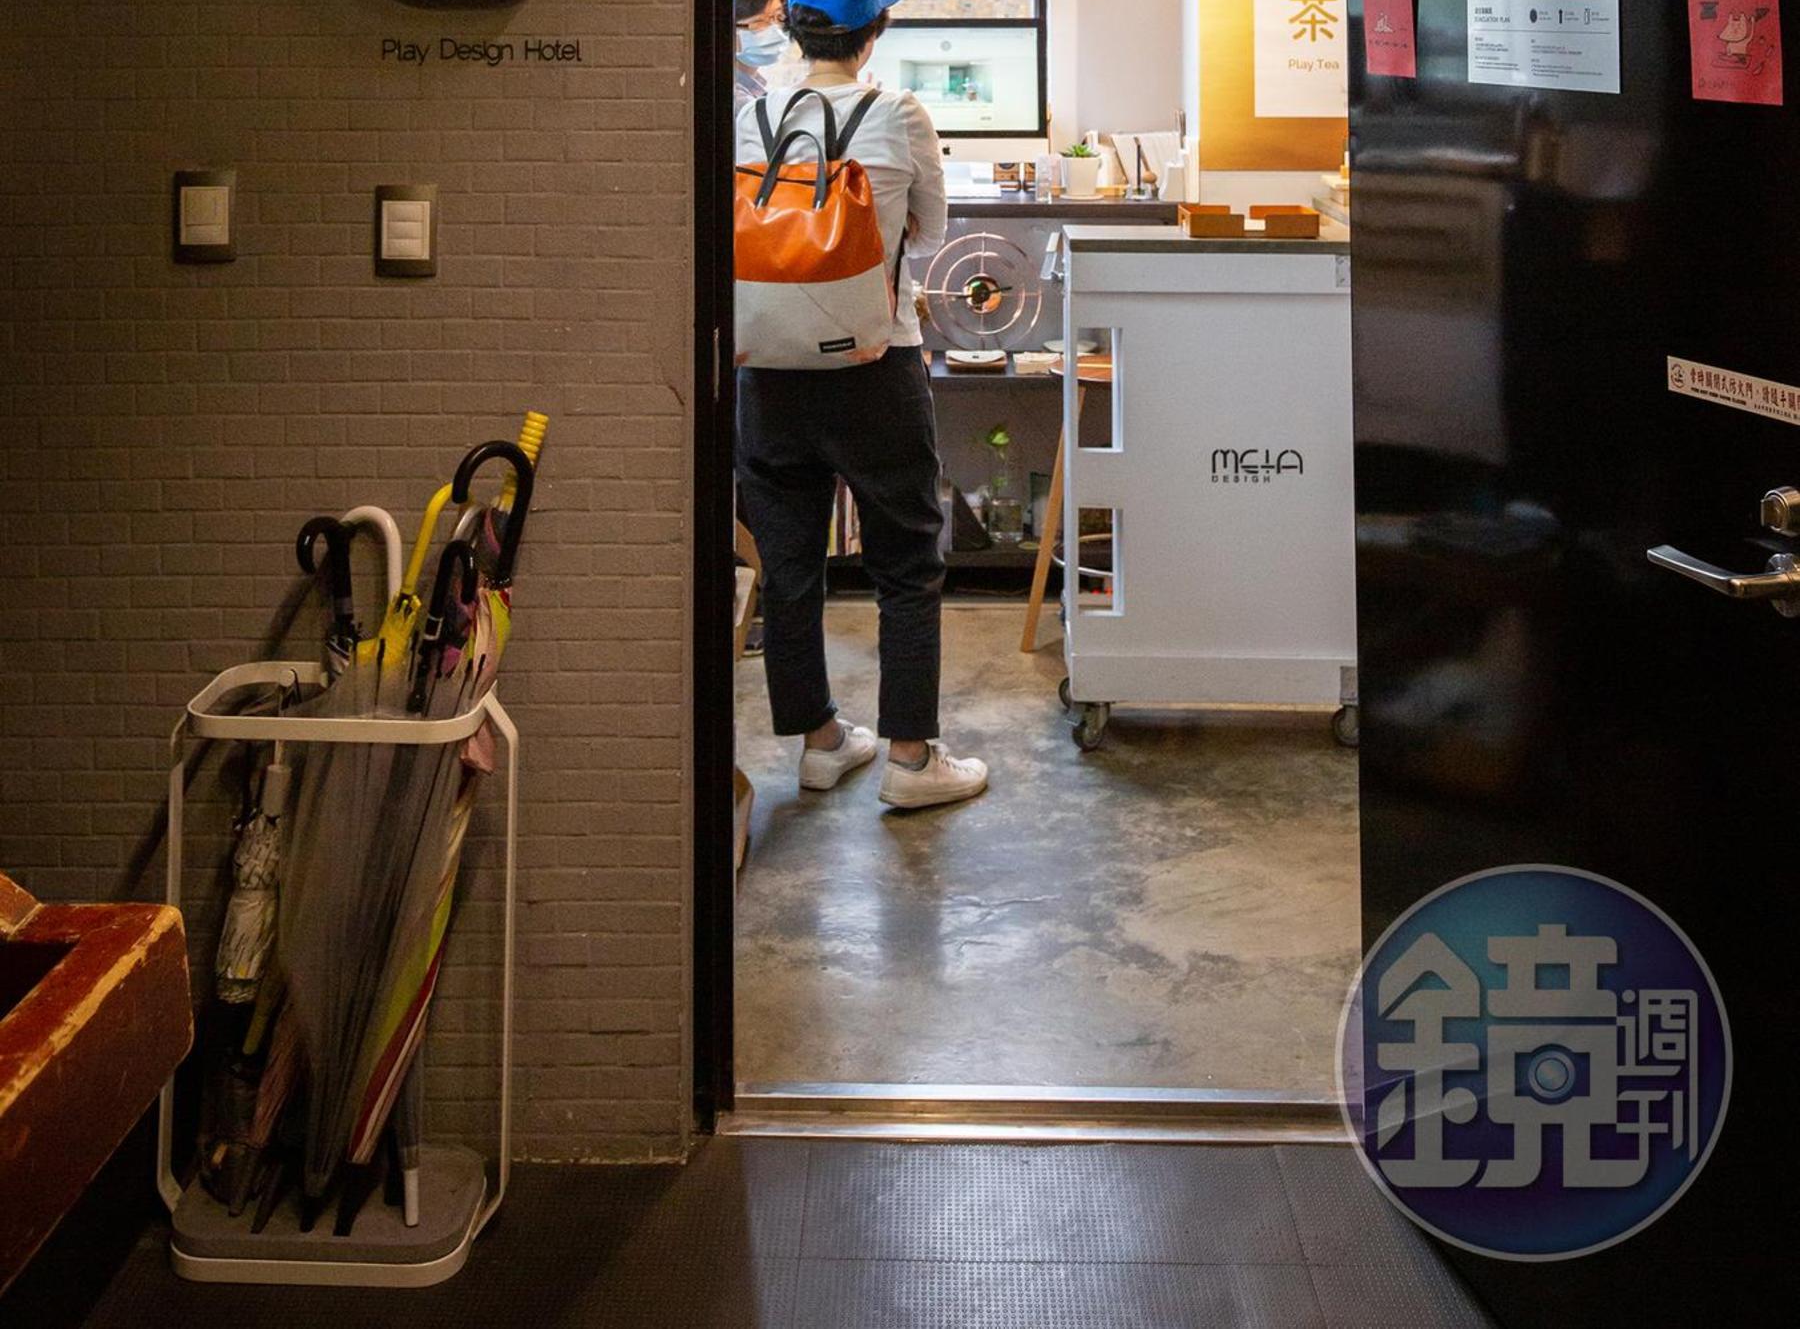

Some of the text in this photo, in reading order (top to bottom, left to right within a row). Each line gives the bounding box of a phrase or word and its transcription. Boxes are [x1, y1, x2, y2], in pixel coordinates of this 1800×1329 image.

[381, 38, 582, 66] Play Design Hotel
[1288, 58, 1340, 71] Play Tea
[1211, 475, 1271, 483] DESIGN
